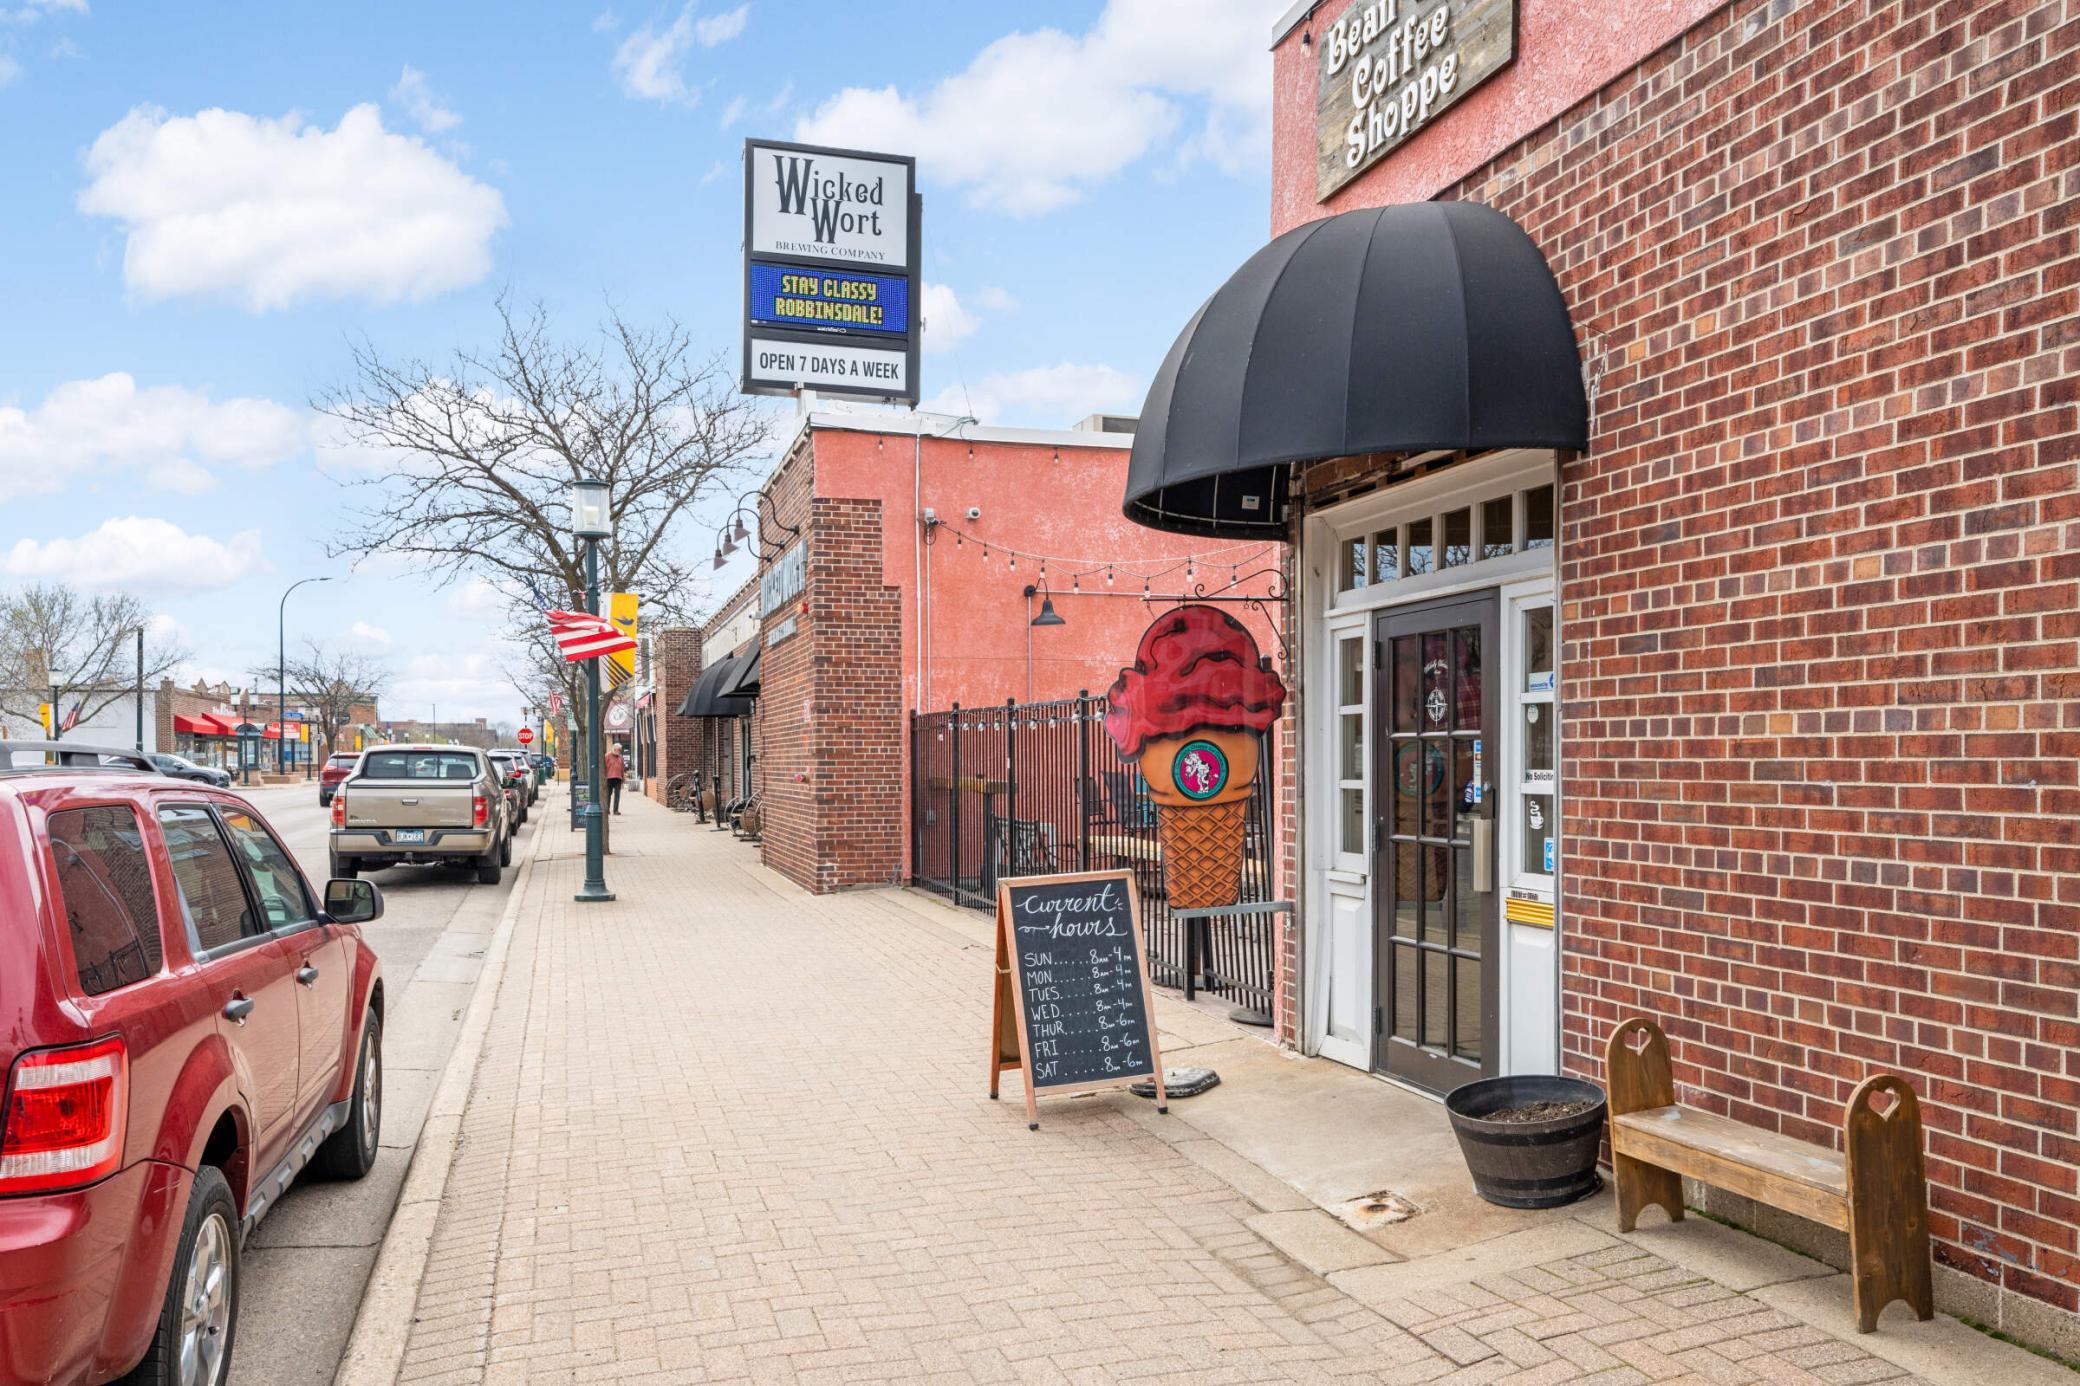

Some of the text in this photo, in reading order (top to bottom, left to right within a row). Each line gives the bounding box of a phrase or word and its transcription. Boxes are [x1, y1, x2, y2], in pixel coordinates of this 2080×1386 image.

[1352, 6, 1448, 109] Coffee
[1346, 53, 1457, 168] Shoppe
[773, 155, 883, 215] Wicked
[810, 198, 882, 244] Wort
[776, 241, 886, 261] BREWING COMPANY
[782, 275, 877, 301] STAY CLASSY
[775, 297, 883, 325] ROBBINSDALE!
[760, 352, 899, 379] OPEN 7 DAYS A WEEK
[518, 732, 533, 740] STOP
[1049, 912, 1128, 939] hours
[1024, 952, 1052, 967] SUN
[1027, 970, 1052, 986] MON
[1029, 986, 1060, 1002] TUES
[1031, 1004, 1060, 1021] WED
[1032, 1021, 1065, 1037] THUR
[1034, 1040, 1059, 1058] FRI
[1036, 1061, 1059, 1079] SAT
